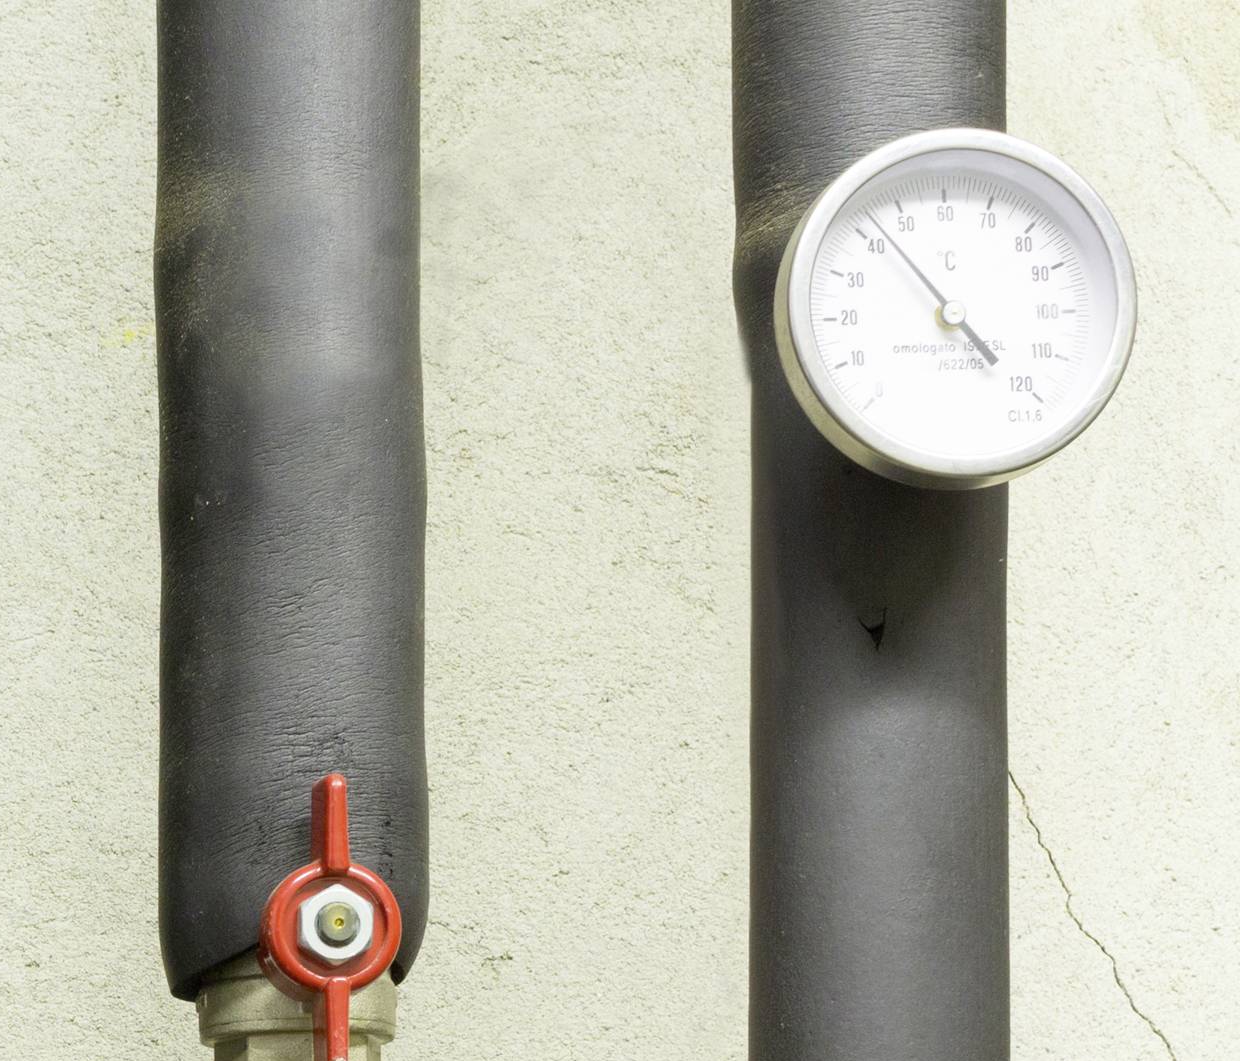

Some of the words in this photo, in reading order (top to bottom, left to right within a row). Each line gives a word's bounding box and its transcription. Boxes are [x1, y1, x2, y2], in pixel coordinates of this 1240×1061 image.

[936, 206, 954, 222] 60
[980, 212, 996, 228] 70
[898, 216, 915, 232] 50
[867, 238, 885, 254] 40
[1015, 236, 1032, 253] 80
[847, 272, 864, 288] 30
[1032, 266, 1048, 282] 90
[840, 310, 858, 326] 20
[1036, 304, 1058, 320] 100
[893, 343, 956, 356] omologato
[963, 340, 1006, 352] ISESL
[1032, 343, 1052, 359] 110
[851, 351, 864, 366] 10
[938, 358, 984, 371] /622/05
[1009, 376, 1033, 392] 120
